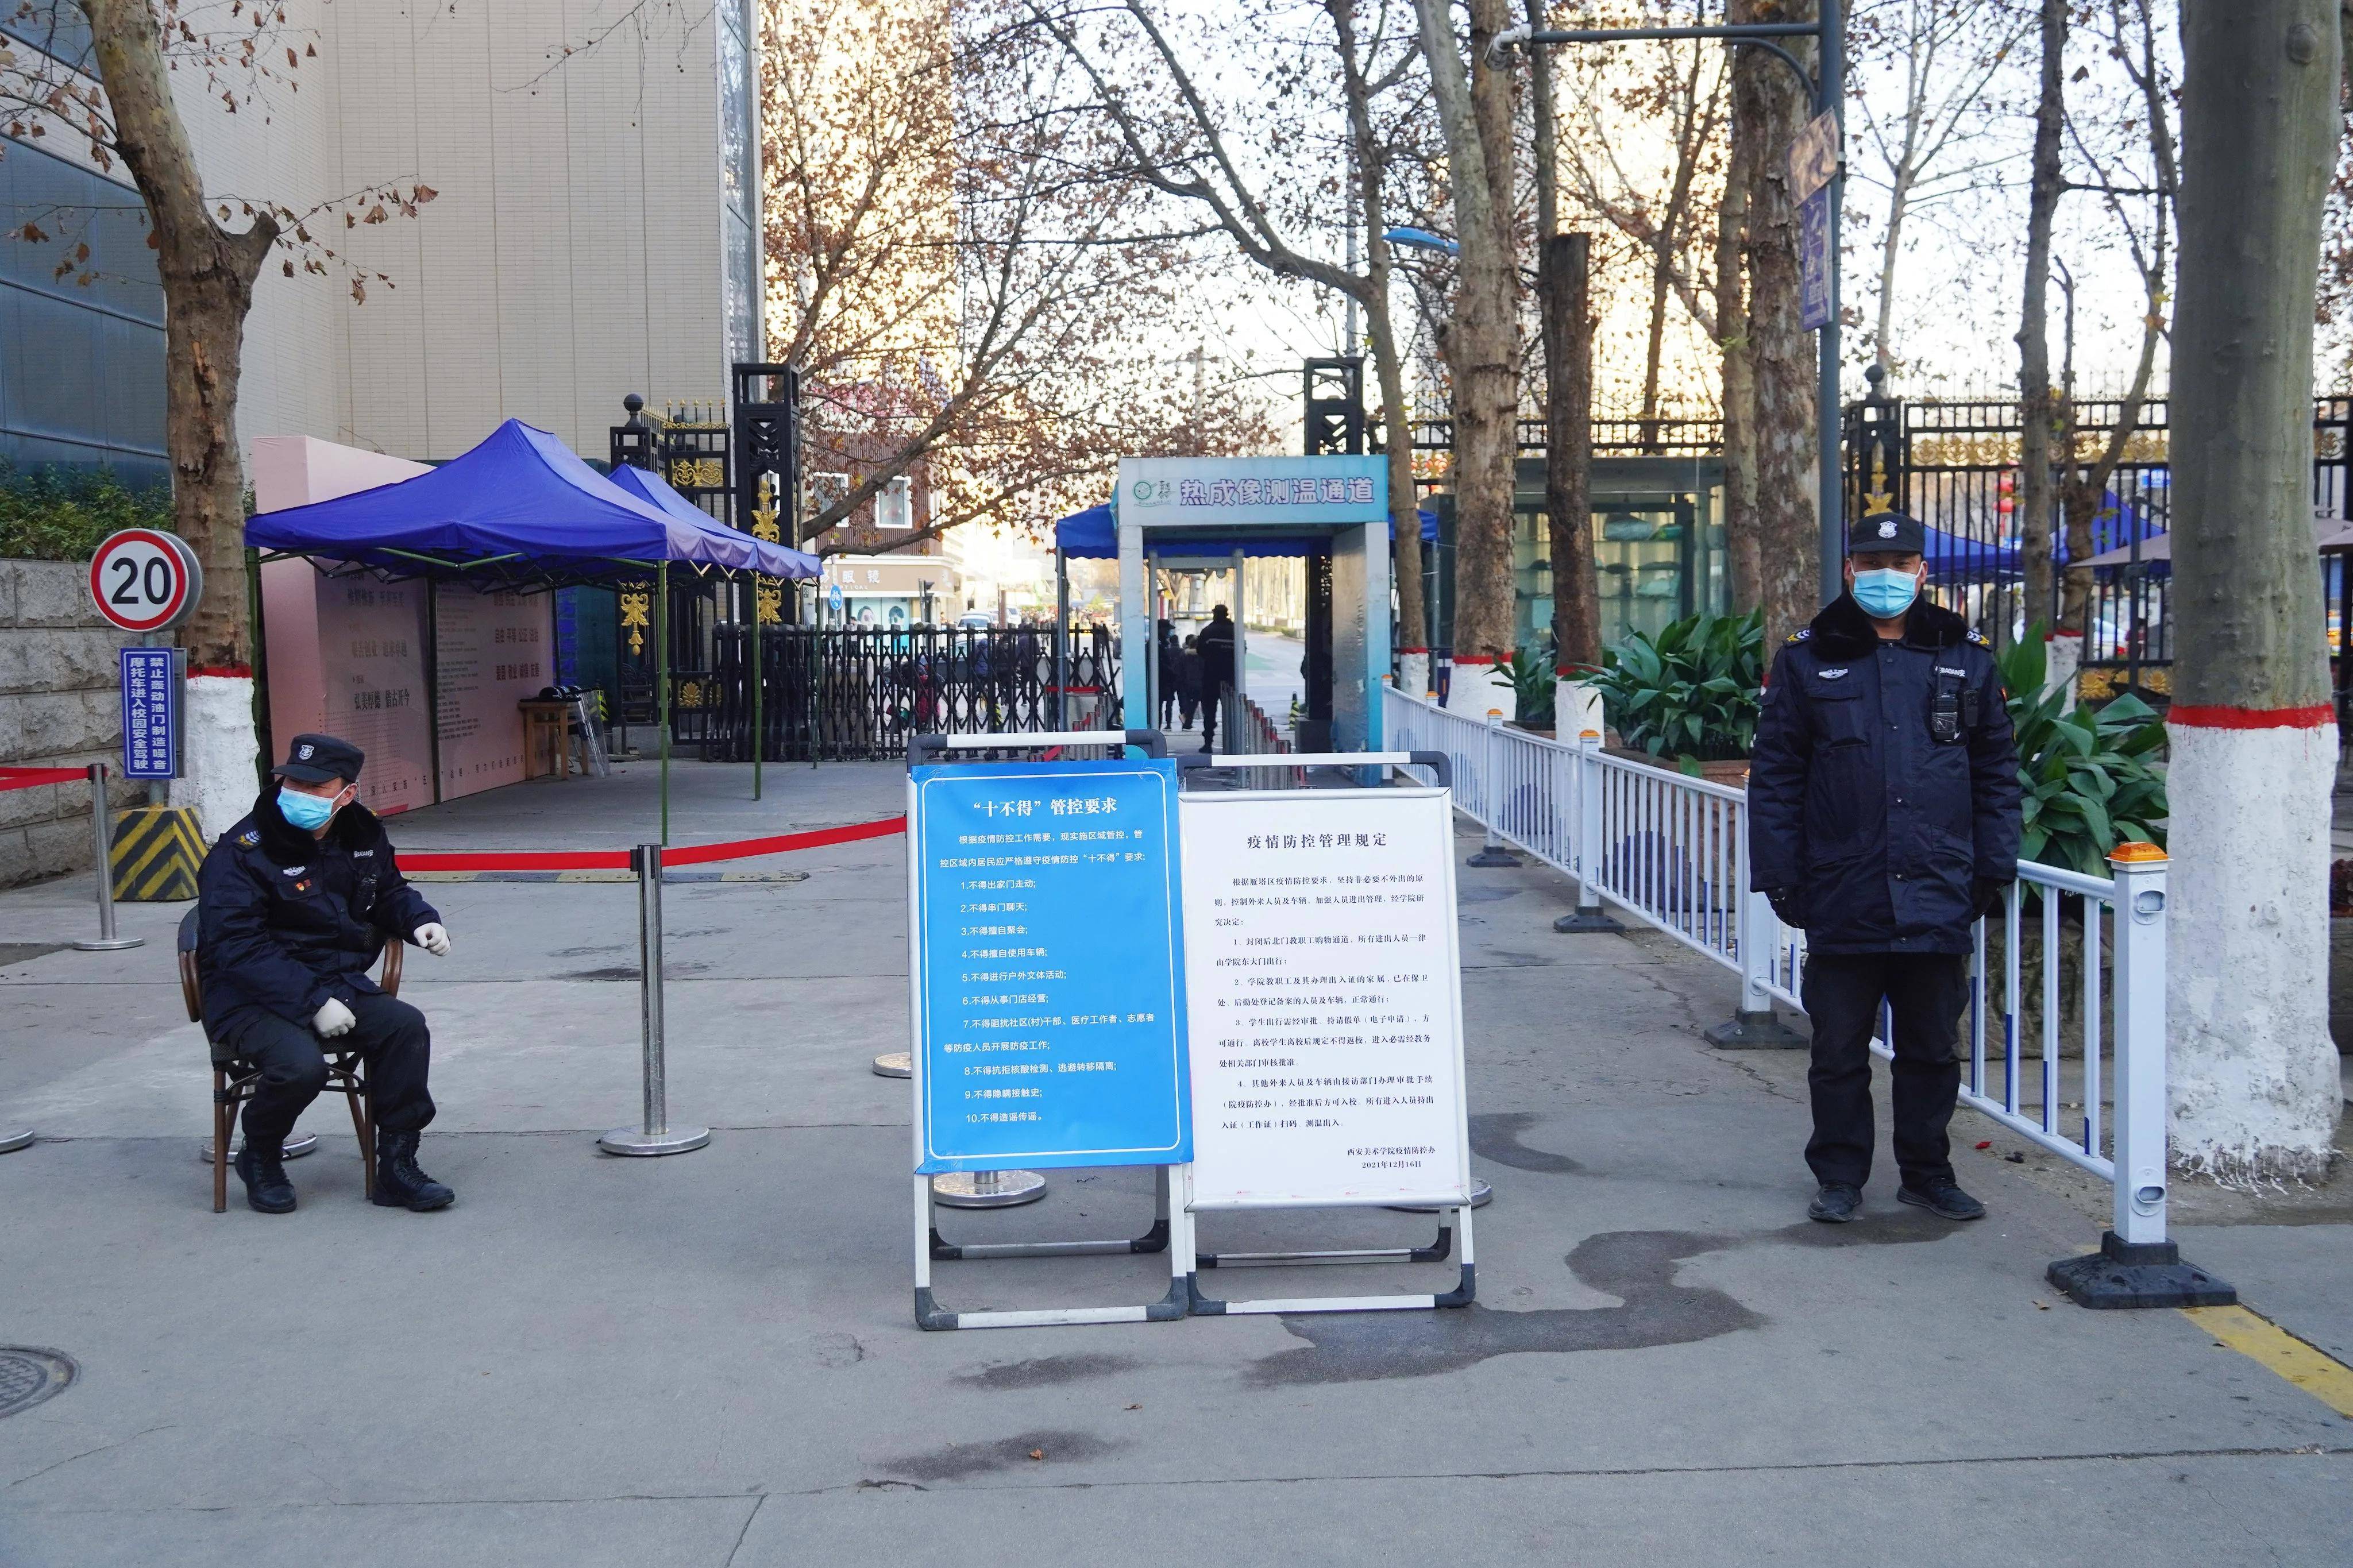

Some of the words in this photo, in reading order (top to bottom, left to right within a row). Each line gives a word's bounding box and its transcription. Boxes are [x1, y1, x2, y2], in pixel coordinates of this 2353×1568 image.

[1179, 477, 1375, 506] 热成像测温通道
[111, 557, 172, 605] 20
[130, 658, 148, 770] 摩托车进入校园安全驾驶
[149, 657, 167, 770] 禁止轰动油门制造噪音
[959, 829, 1143, 844] 根据疫情防控工作需要，现实施区域管控，管
[1247, 833, 1387, 849] 疫情防控管理规定
[1233, 874, 1424, 886] 根据雁塔区疫情防控要求，坚持非必要不外出的原
[1347, 1146, 1436, 1156] 西安美术学院疫情防控办
[1362, 1161, 1422, 1169] 2021年12月16日
